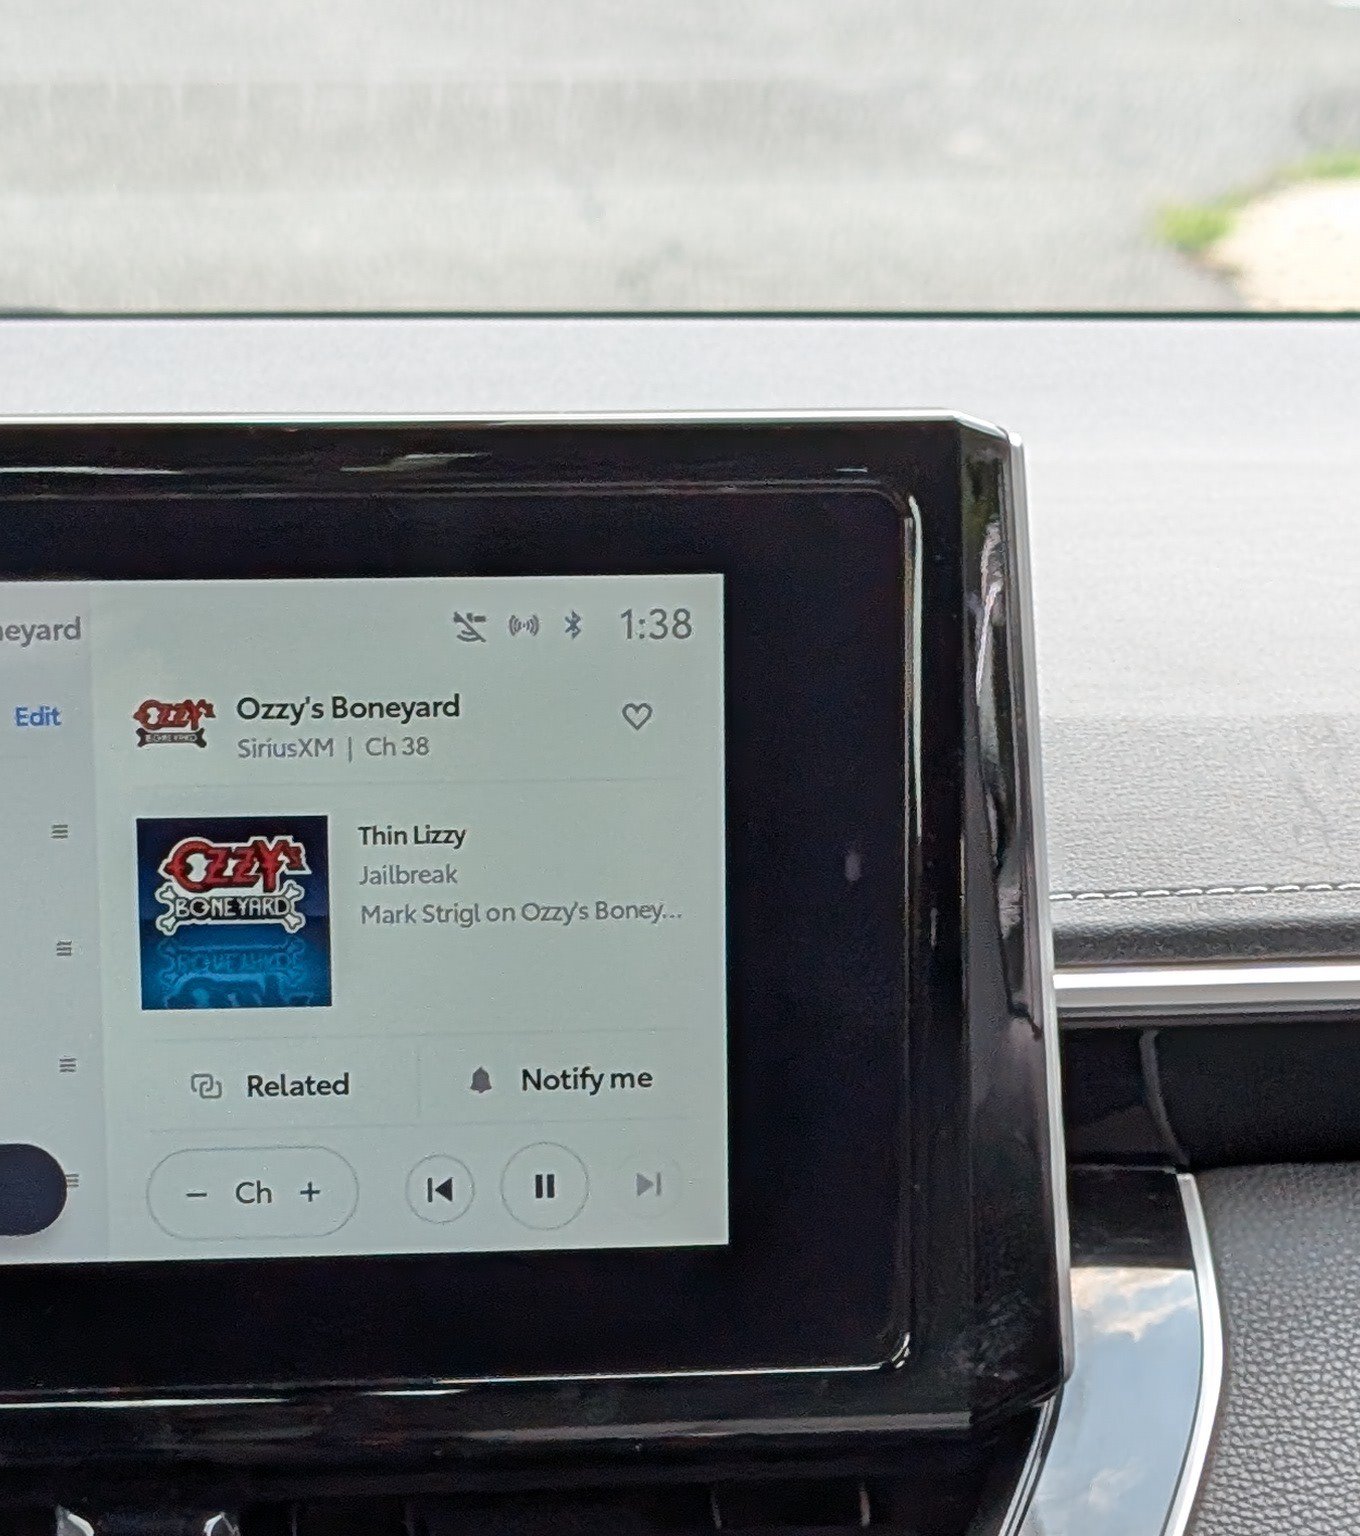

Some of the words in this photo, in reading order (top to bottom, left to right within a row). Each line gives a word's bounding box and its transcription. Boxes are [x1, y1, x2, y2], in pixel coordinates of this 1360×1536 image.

[619, 607, 693, 640] 1:38
[14, 705, 62, 728] Edit
[236, 696, 324, 724] Ozzy's
[330, 693, 461, 724] Boneyard
[237, 736, 335, 760] SiriusXM
[365, 736, 397, 757] Ch
[401, 735, 430, 757] 38
[358, 826, 409, 848] Thin
[413, 825, 467, 849] Lizzy
[358, 864, 459, 887] Jailbreak
[175, 896, 290, 918] BONEYARD
[359, 904, 417, 926] Mark
[421, 902, 482, 929] Strigl
[486, 907, 516, 924] on
[521, 901, 590, 928] Ozzy's
[246, 1073, 351, 1098] Related
[521, 1066, 605, 1097] Notify
[610, 1069, 654, 1091] me
[234, 1181, 273, 1205] Ch
